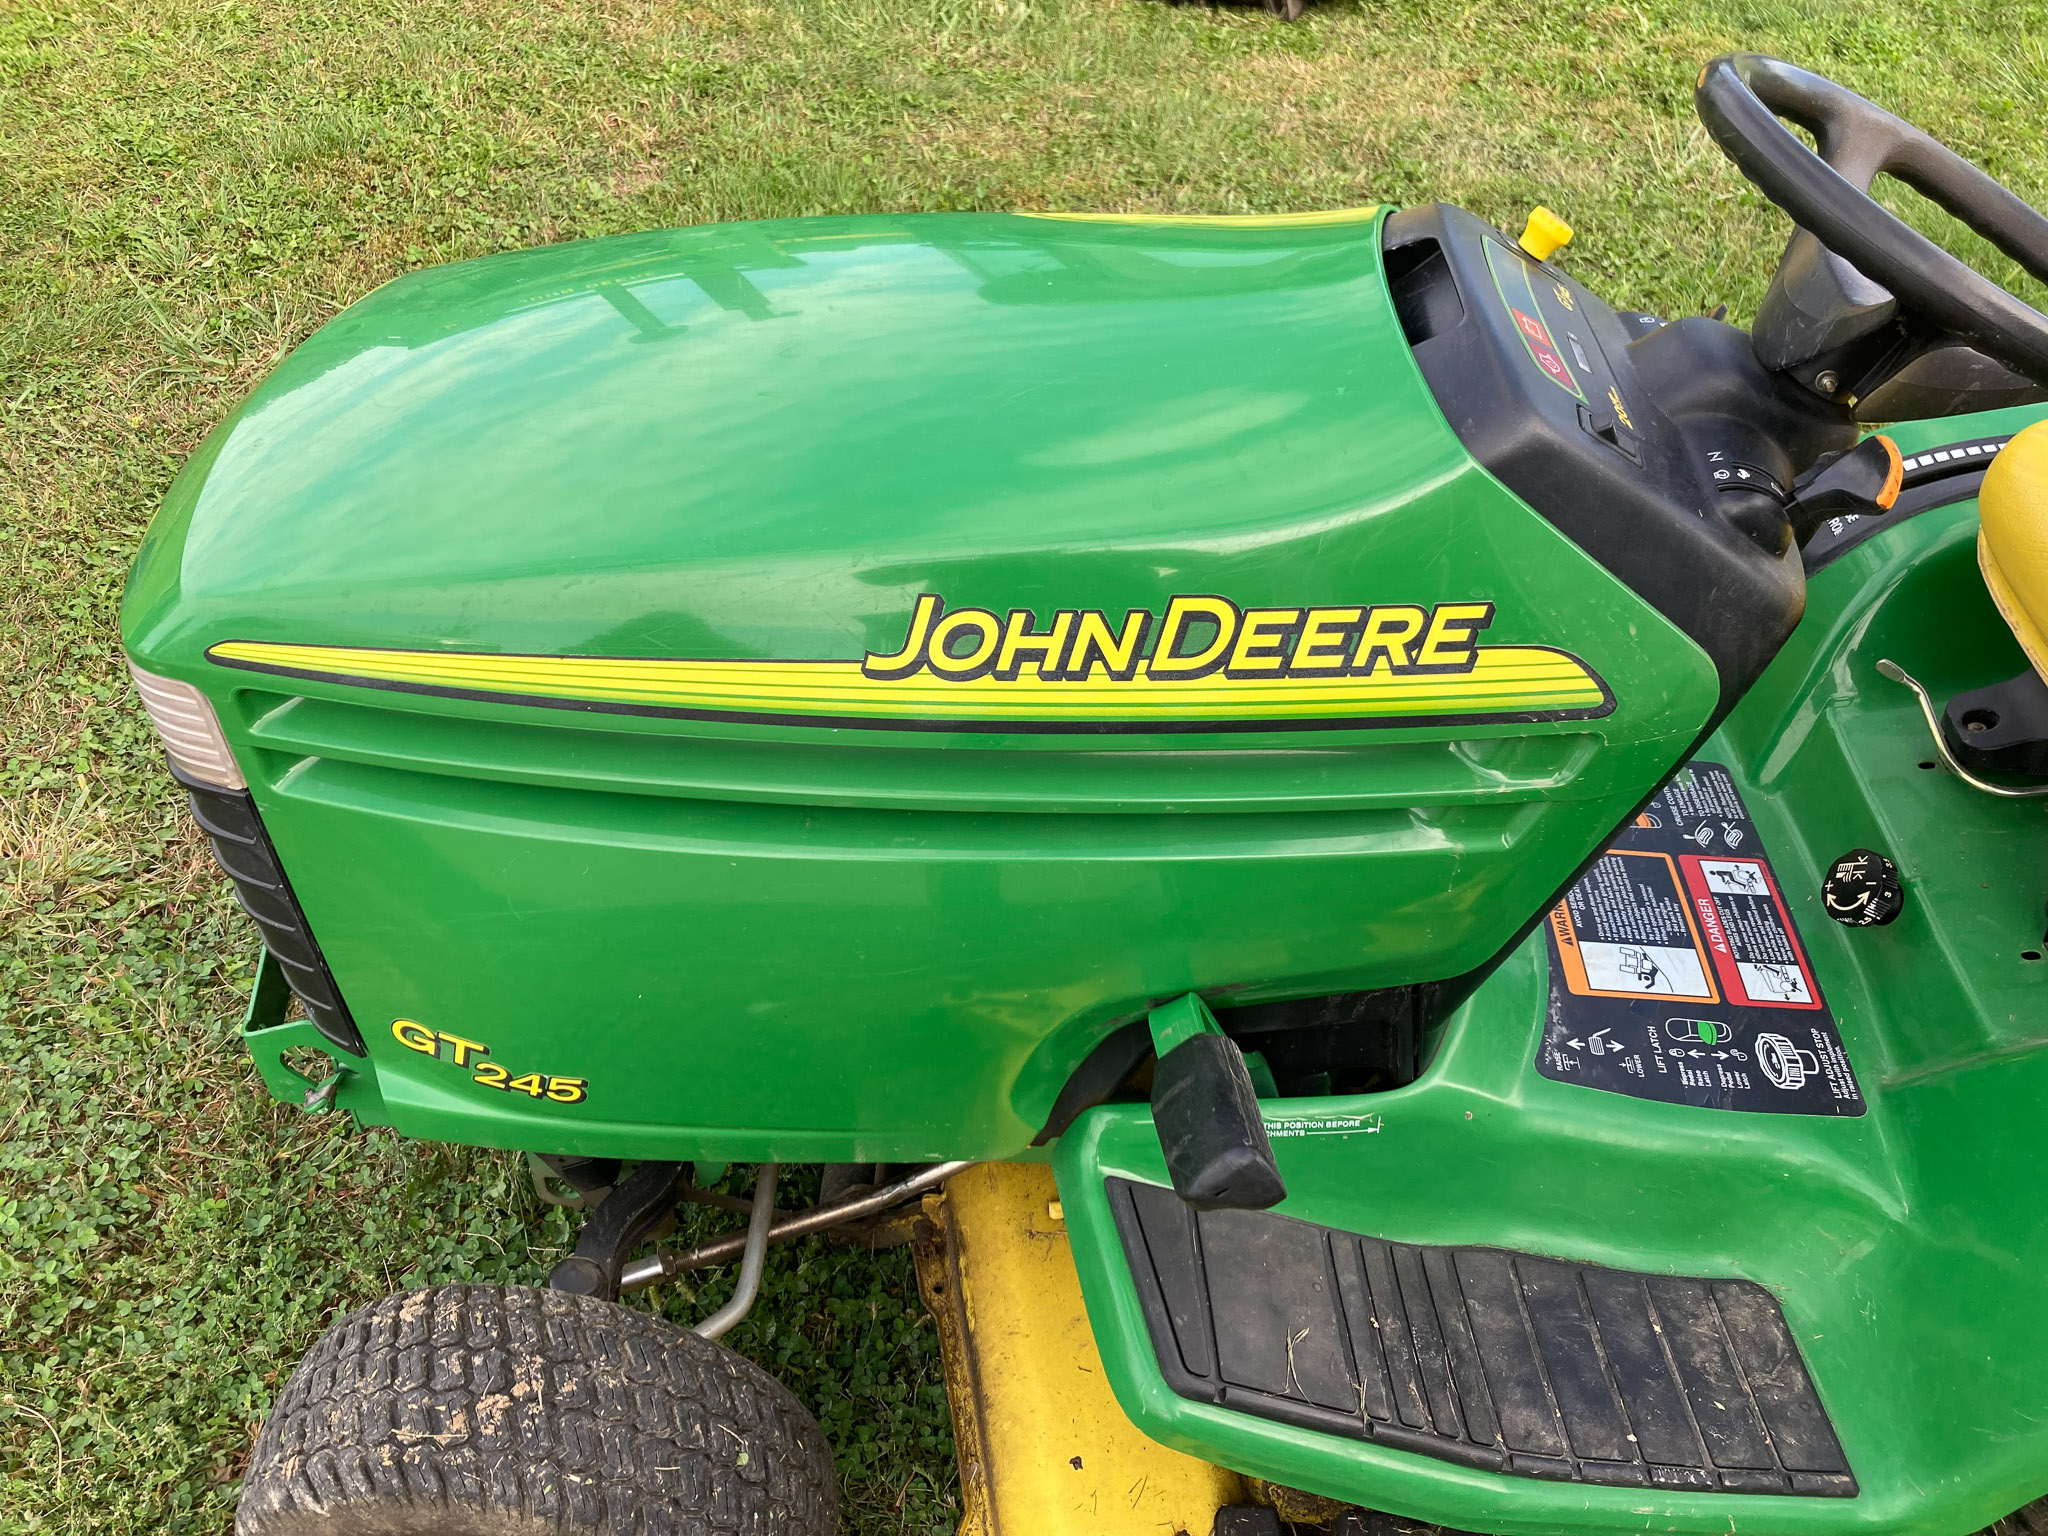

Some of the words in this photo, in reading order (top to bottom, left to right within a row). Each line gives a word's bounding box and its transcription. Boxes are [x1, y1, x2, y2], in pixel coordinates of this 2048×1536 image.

[1707, 451, 1723, 462] N
[862, 592, 1152, 682] JOHN
[1146, 594, 1495, 682] DEERE
[1672, 788, 1686, 808] ENGAGE
[1669, 805, 1684, 826] CRUISE
[1610, 857, 1620, 875] working
[1616, 856, 1625, 872] thrown
[1601, 873, 1610, 886] down
[1623, 878, 1632, 891] could
[1598, 883, 1608, 896] going
[1605, 887, 1614, 898] back
[1619, 885, 1628, 898] place
[1638, 883, 1648, 901] manual
[1577, 900, 1586, 910] OR
[1587, 893, 1596, 906] down
[1602, 897, 1612, 910] stops
[1614, 891, 1624, 909] devices
[1662, 896, 1672, 910] brake
[1671, 902, 1680, 911] key
[1712, 896, 1721, 905] OFF
[1571, 909, 1583, 927] AVOID
[1590, 906, 1598, 916] and
[1597, 903, 1607, 921] sudden
[1612, 909, 1622, 925] blades
[1619, 910, 1629, 925] safety
[1630, 902, 1641, 919] objects
[1638, 907, 1648, 923] blades
[1644, 902, 1657, 926] operator's
[1653, 908, 1664, 925] leaving
[1658, 902, 1668, 918] engine
[1667, 911, 1676, 922] park
[1716, 906, 1724, 915] CUT
[1723, 908, 1733, 921] LEGS
[1554, 902, 1571, 937] WARN
[1606, 911, 1617, 932] machine
[1663, 919, 1672, 931] Stop
[1671, 923, 1679, 932] Set
[1674, 912, 1686, 932] Remove
[1697, 898, 1723, 942] DANGER
[1720, 916, 1732, 934] BLADES
[1728, 922, 1737, 931] AND
[1595, 923, 1604, 936] Drive
[1602, 922, 1612, 936] Avoid
[1617, 926, 1627, 937] stop
[1624, 925, 1634, 938] Keep
[1636, 919, 1647, 939] Remove
[1652, 927, 1661, 940] Read
[1658, 926, 1668, 940] When
[1726, 935, 1741, 959] ROTATING
[1732, 932, 1742, 946] ARMS
[391, 1018, 490, 1069] GT
[1645, 1025, 1662, 1053] LATCH
[1809, 1027, 1825, 1048] STOP
[1820, 1031, 1838, 1063] implement
[1553, 1051, 1564, 1070] RAISE
[1632, 1054, 1644, 1077] LOWER
[1653, 1054, 1667, 1073] LIFT
[1817, 1049, 1836, 1080] ADJUST
[1674, 1061, 1689, 1085] Depress
[1685, 1069, 1696, 1086] Pedal
[1693, 1069, 1705, 1086] Raise
[1700, 1069, 1712, 1086] Latch
[1714, 1063, 1728, 1087] Depress
[1832, 1063, 1842, 1077] with
[473, 1061, 588, 1104] 245
[1724, 1071, 1735, 1088] Pedal
[1732, 1070, 1743, 1088] Lower
[1740, 1072, 1751, 1089] Latch
[1842, 1072, 1855, 1091] raised
[1829, 1081, 1842, 1099] LIFT
[1837, 1077, 1850, 1099] Adjust
[1264, 1122, 1282, 1130] THIS
[1284, 1120, 1324, 1129] POSITION
[1326, 1120, 1360, 1128] BEFORE
